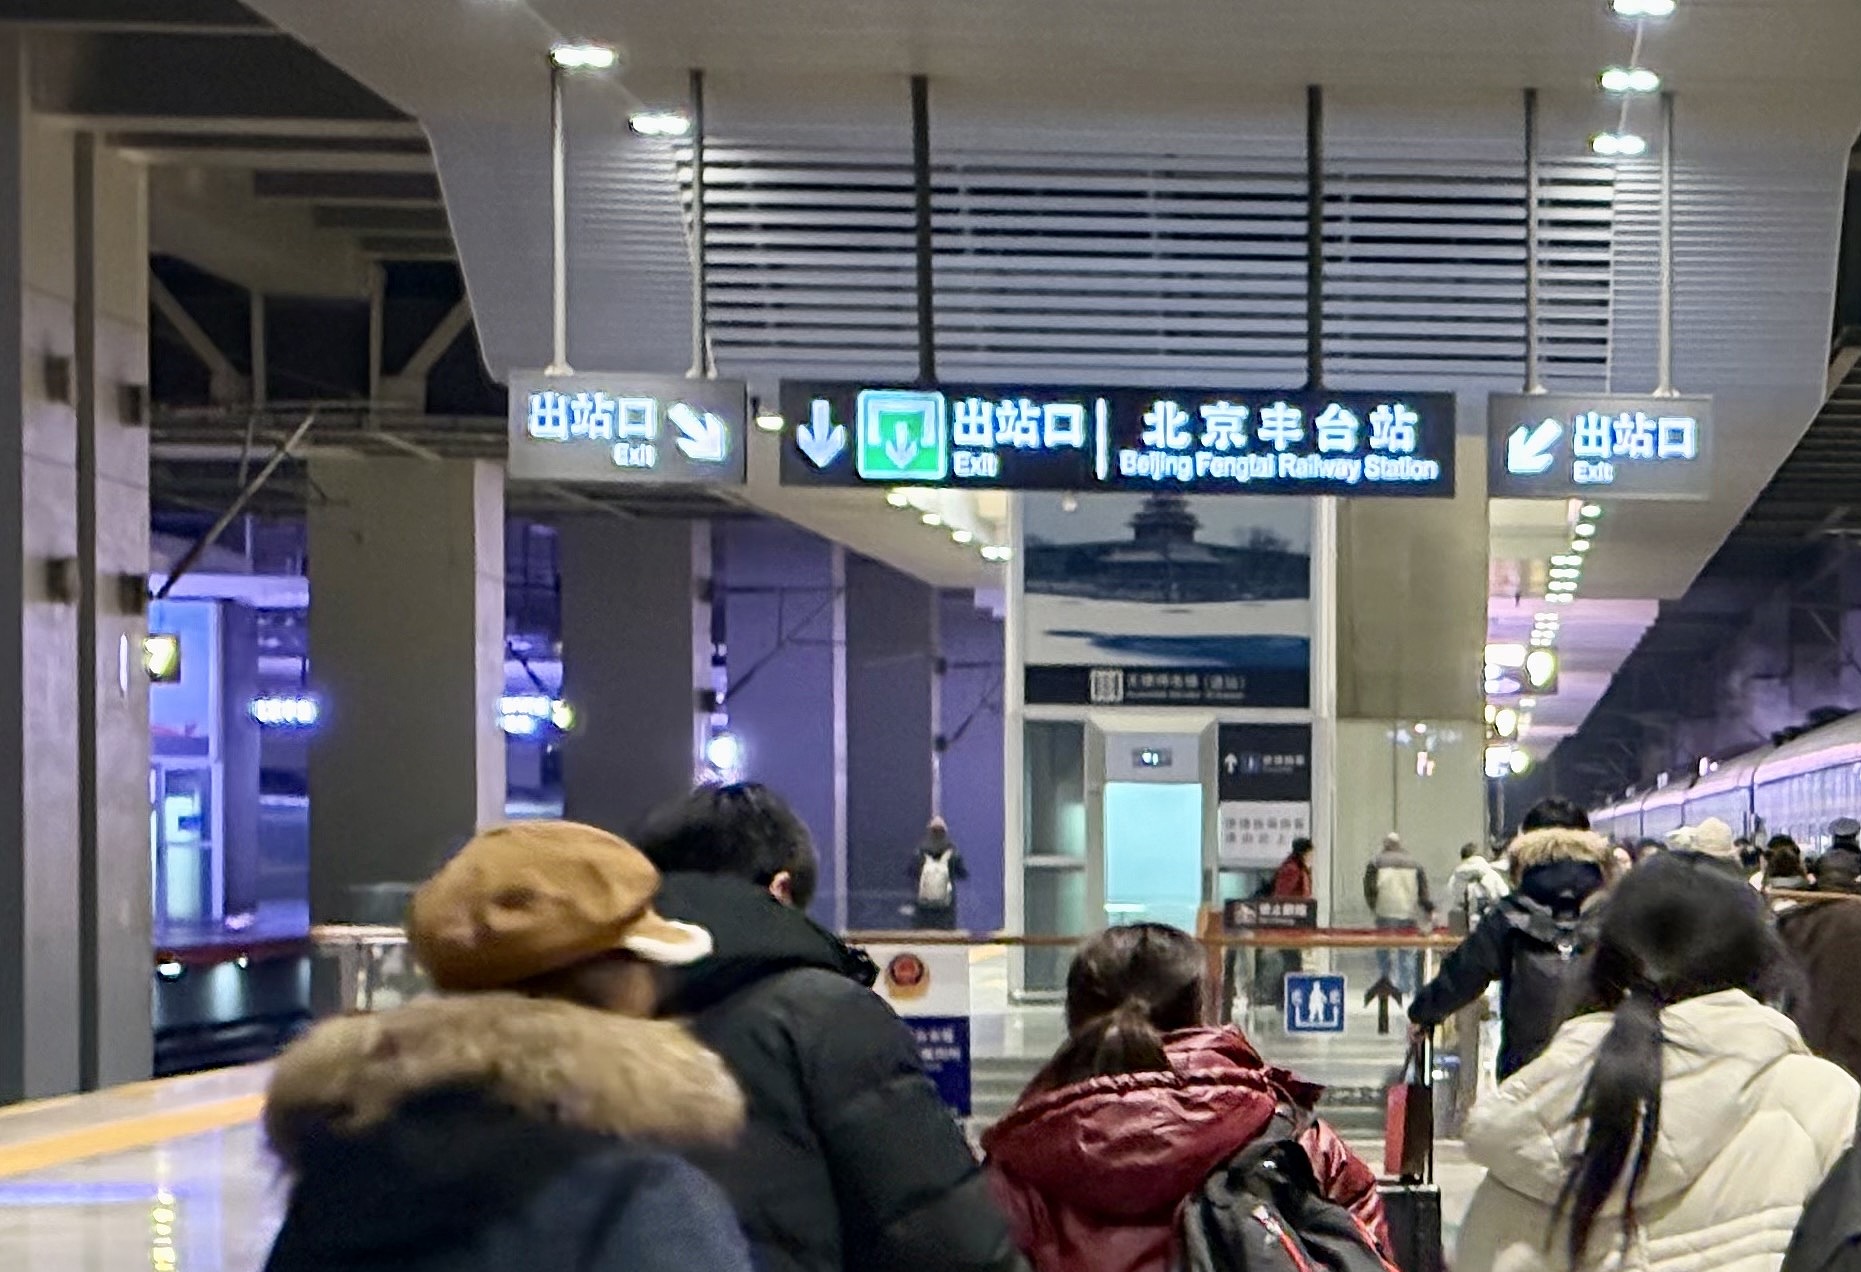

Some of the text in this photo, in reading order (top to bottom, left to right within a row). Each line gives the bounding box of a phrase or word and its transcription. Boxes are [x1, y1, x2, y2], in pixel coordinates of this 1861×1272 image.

[529, 391, 656, 440] 出站口
[953, 398, 1084, 447] 出站口
[1141, 400, 1419, 452] 北京丰台站
[1573, 411, 1697, 459] 出站口
[613, 442, 656, 467] Exit
[952, 451, 999, 477] Exit
[1119, 449, 1439, 484] Beijing Fengtai Railway Station
[1573, 460, 1614, 484] Exit
